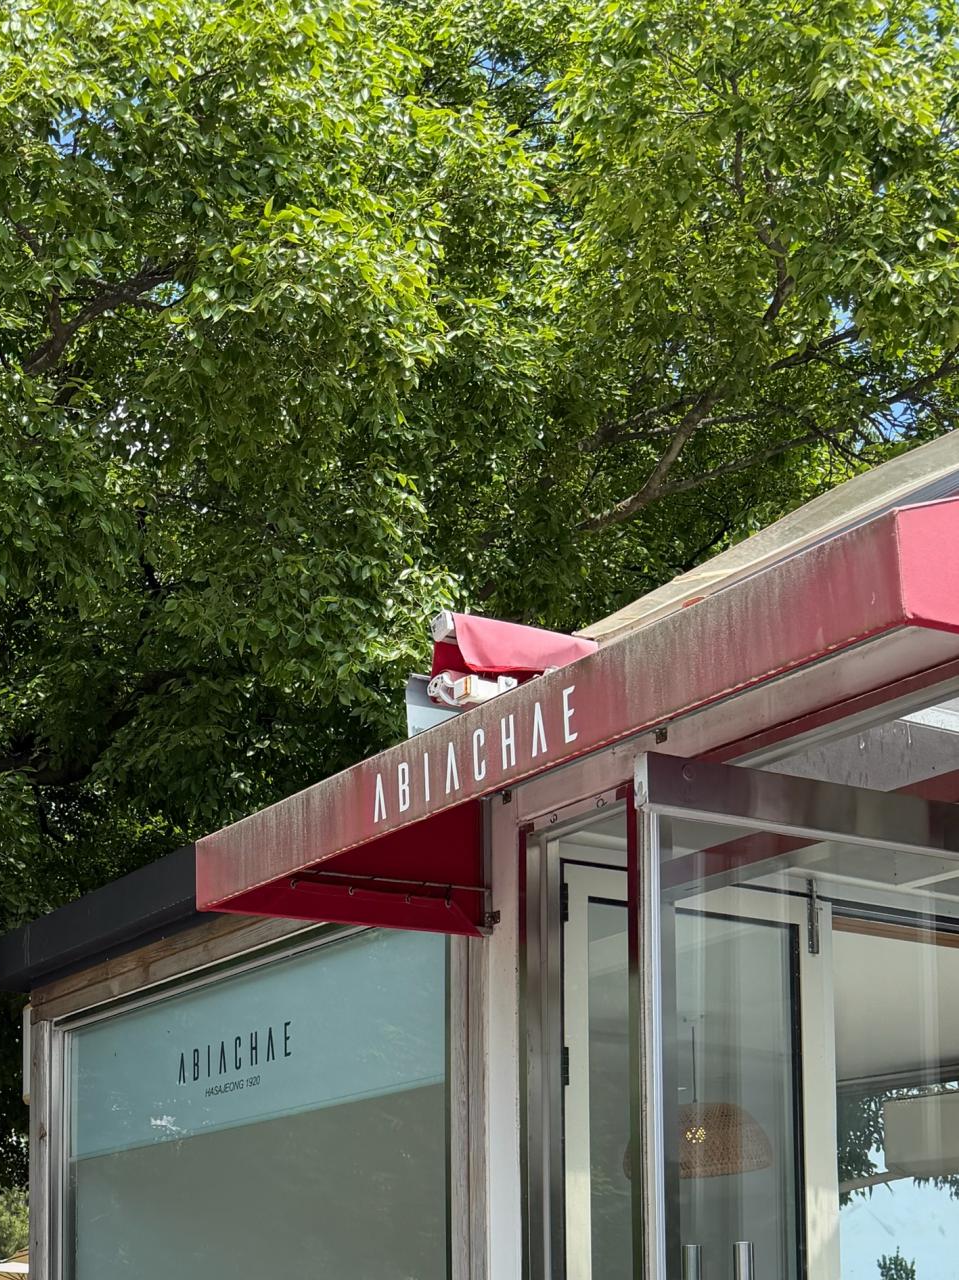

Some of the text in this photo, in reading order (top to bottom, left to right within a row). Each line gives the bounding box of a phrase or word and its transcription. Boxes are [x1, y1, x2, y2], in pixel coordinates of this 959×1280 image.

[373, 684, 579, 823] ABIACHAE
[178, 1020, 292, 1085] ABIACHAE
[204, 1075, 261, 1097] HASAJEONG 1920
